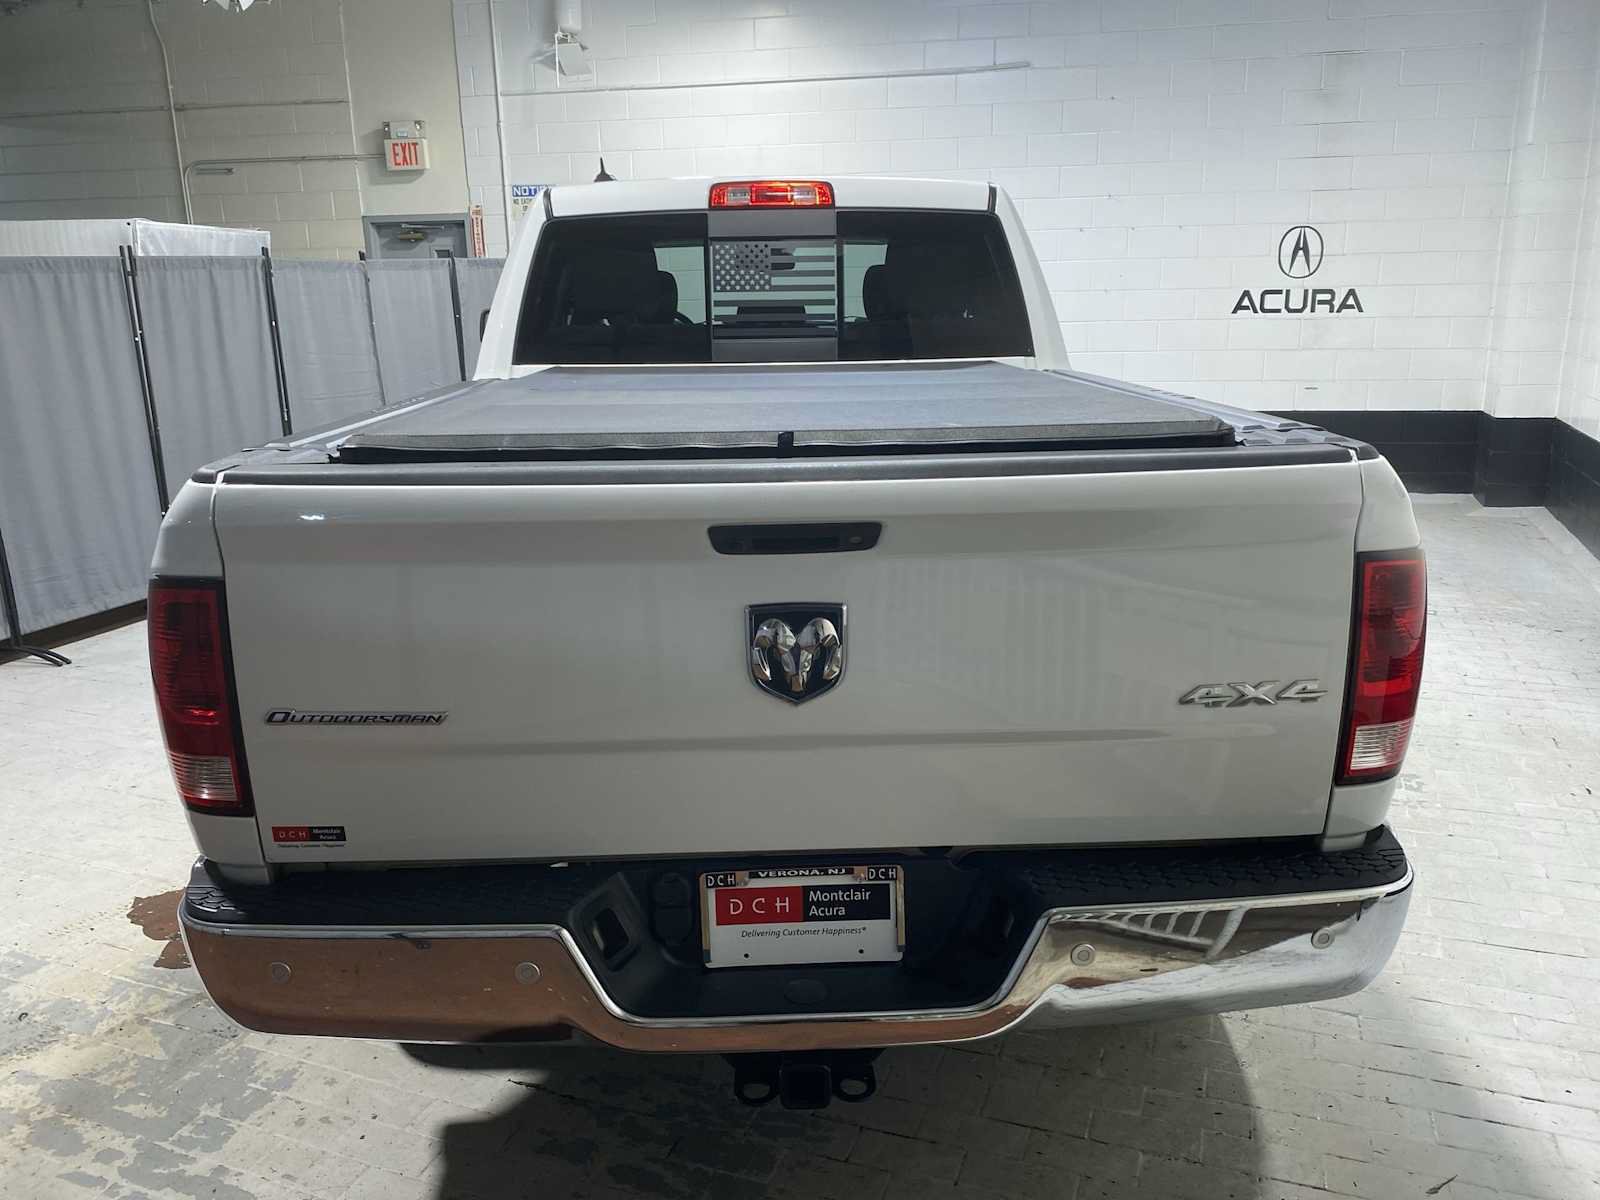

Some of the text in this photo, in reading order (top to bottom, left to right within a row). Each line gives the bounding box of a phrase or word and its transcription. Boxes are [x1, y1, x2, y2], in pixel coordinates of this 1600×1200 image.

[392, 142, 418, 166] EXIT
[1232, 288, 1364, 314] ACURA
[809, 889, 871, 902] Montclair
[809, 904, 846, 917] Acura
[741, 928, 781, 939] Delivering
[783, 927, 821, 937] Customer
